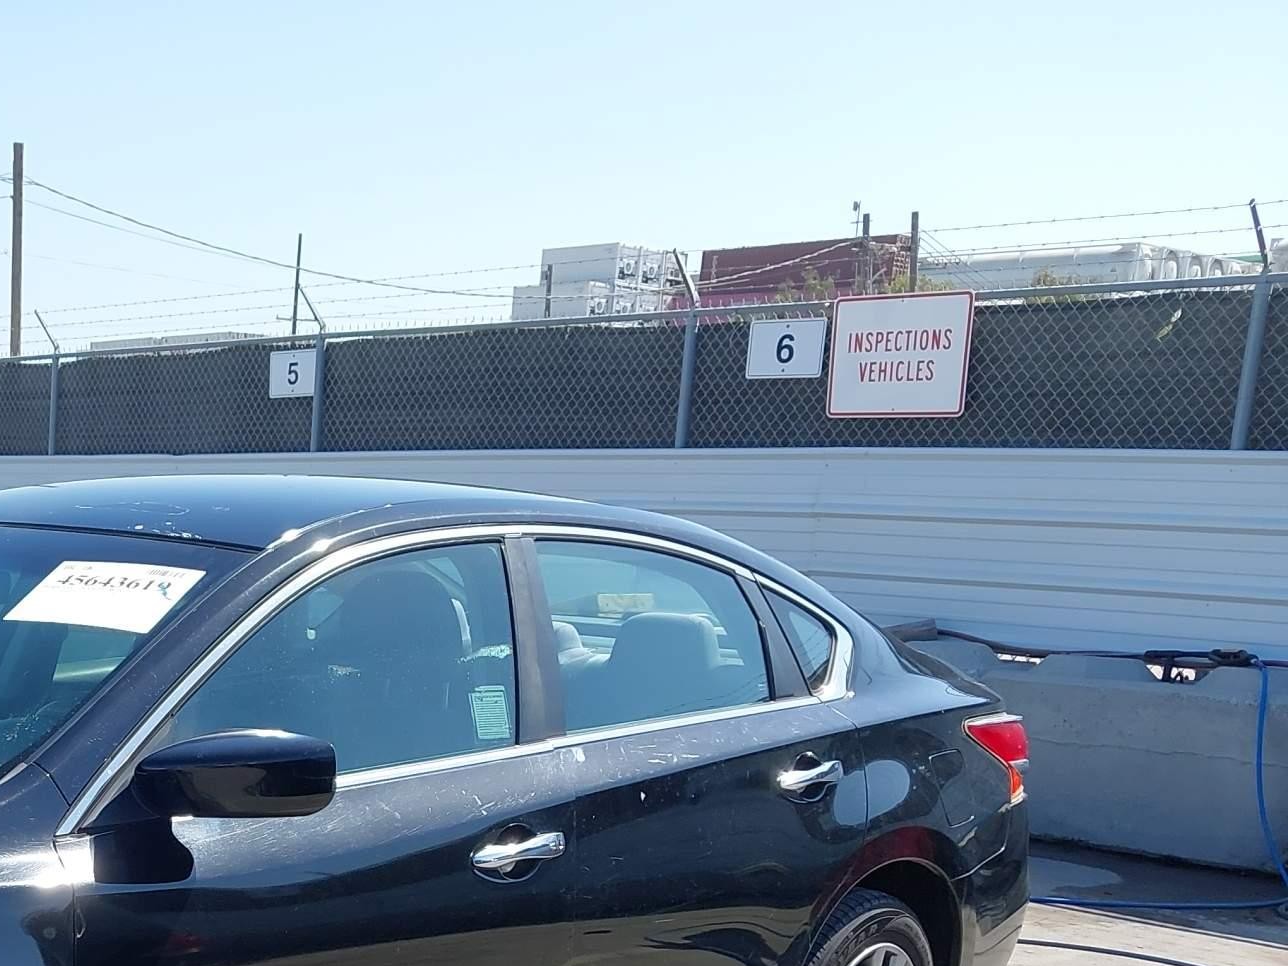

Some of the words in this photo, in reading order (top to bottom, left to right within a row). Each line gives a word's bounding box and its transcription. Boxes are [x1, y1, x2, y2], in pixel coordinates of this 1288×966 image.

[775, 333, 796, 364] 6
[847, 328, 953, 354] INSPECTIONS
[287, 362, 299, 385] 5
[858, 359, 936, 383] VEHICLES
[56, 574, 172, 591] 45643619
